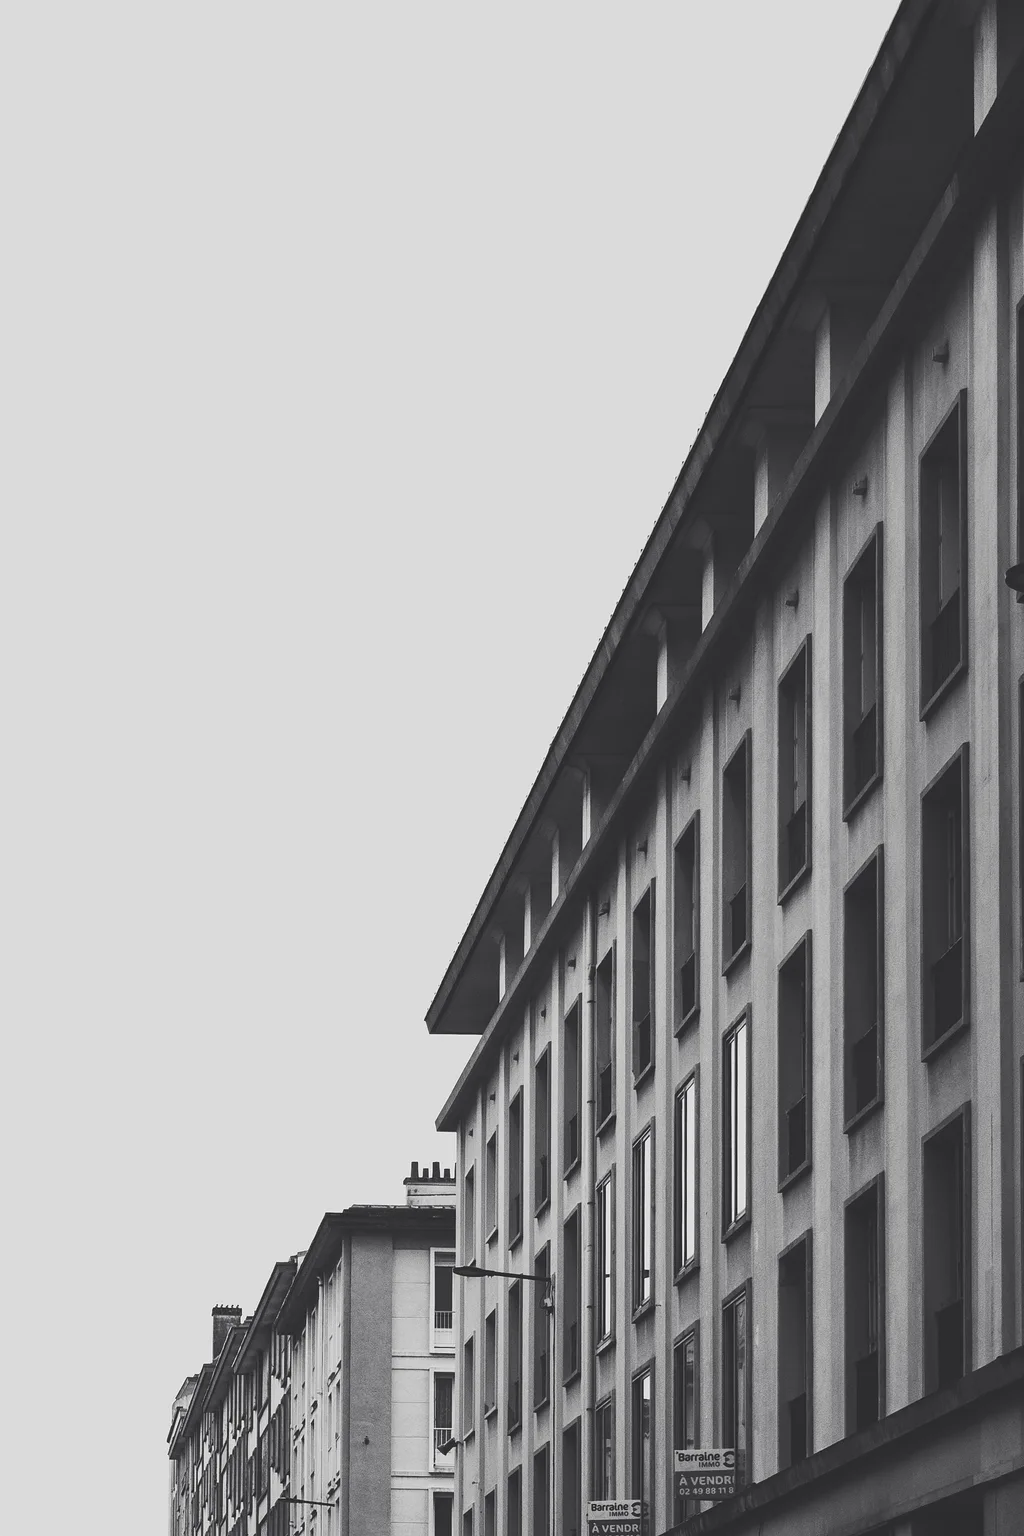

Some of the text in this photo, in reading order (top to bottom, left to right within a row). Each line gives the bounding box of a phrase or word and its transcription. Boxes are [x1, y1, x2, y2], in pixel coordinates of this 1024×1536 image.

[678, 1453, 720, 1462] Barraine
[679, 1475, 687, 1486] À
[679, 1488, 690, 1496] 02
[591, 1503, 629, 1512] Barraine
[592, 1523, 641, 1534] À VENDR
